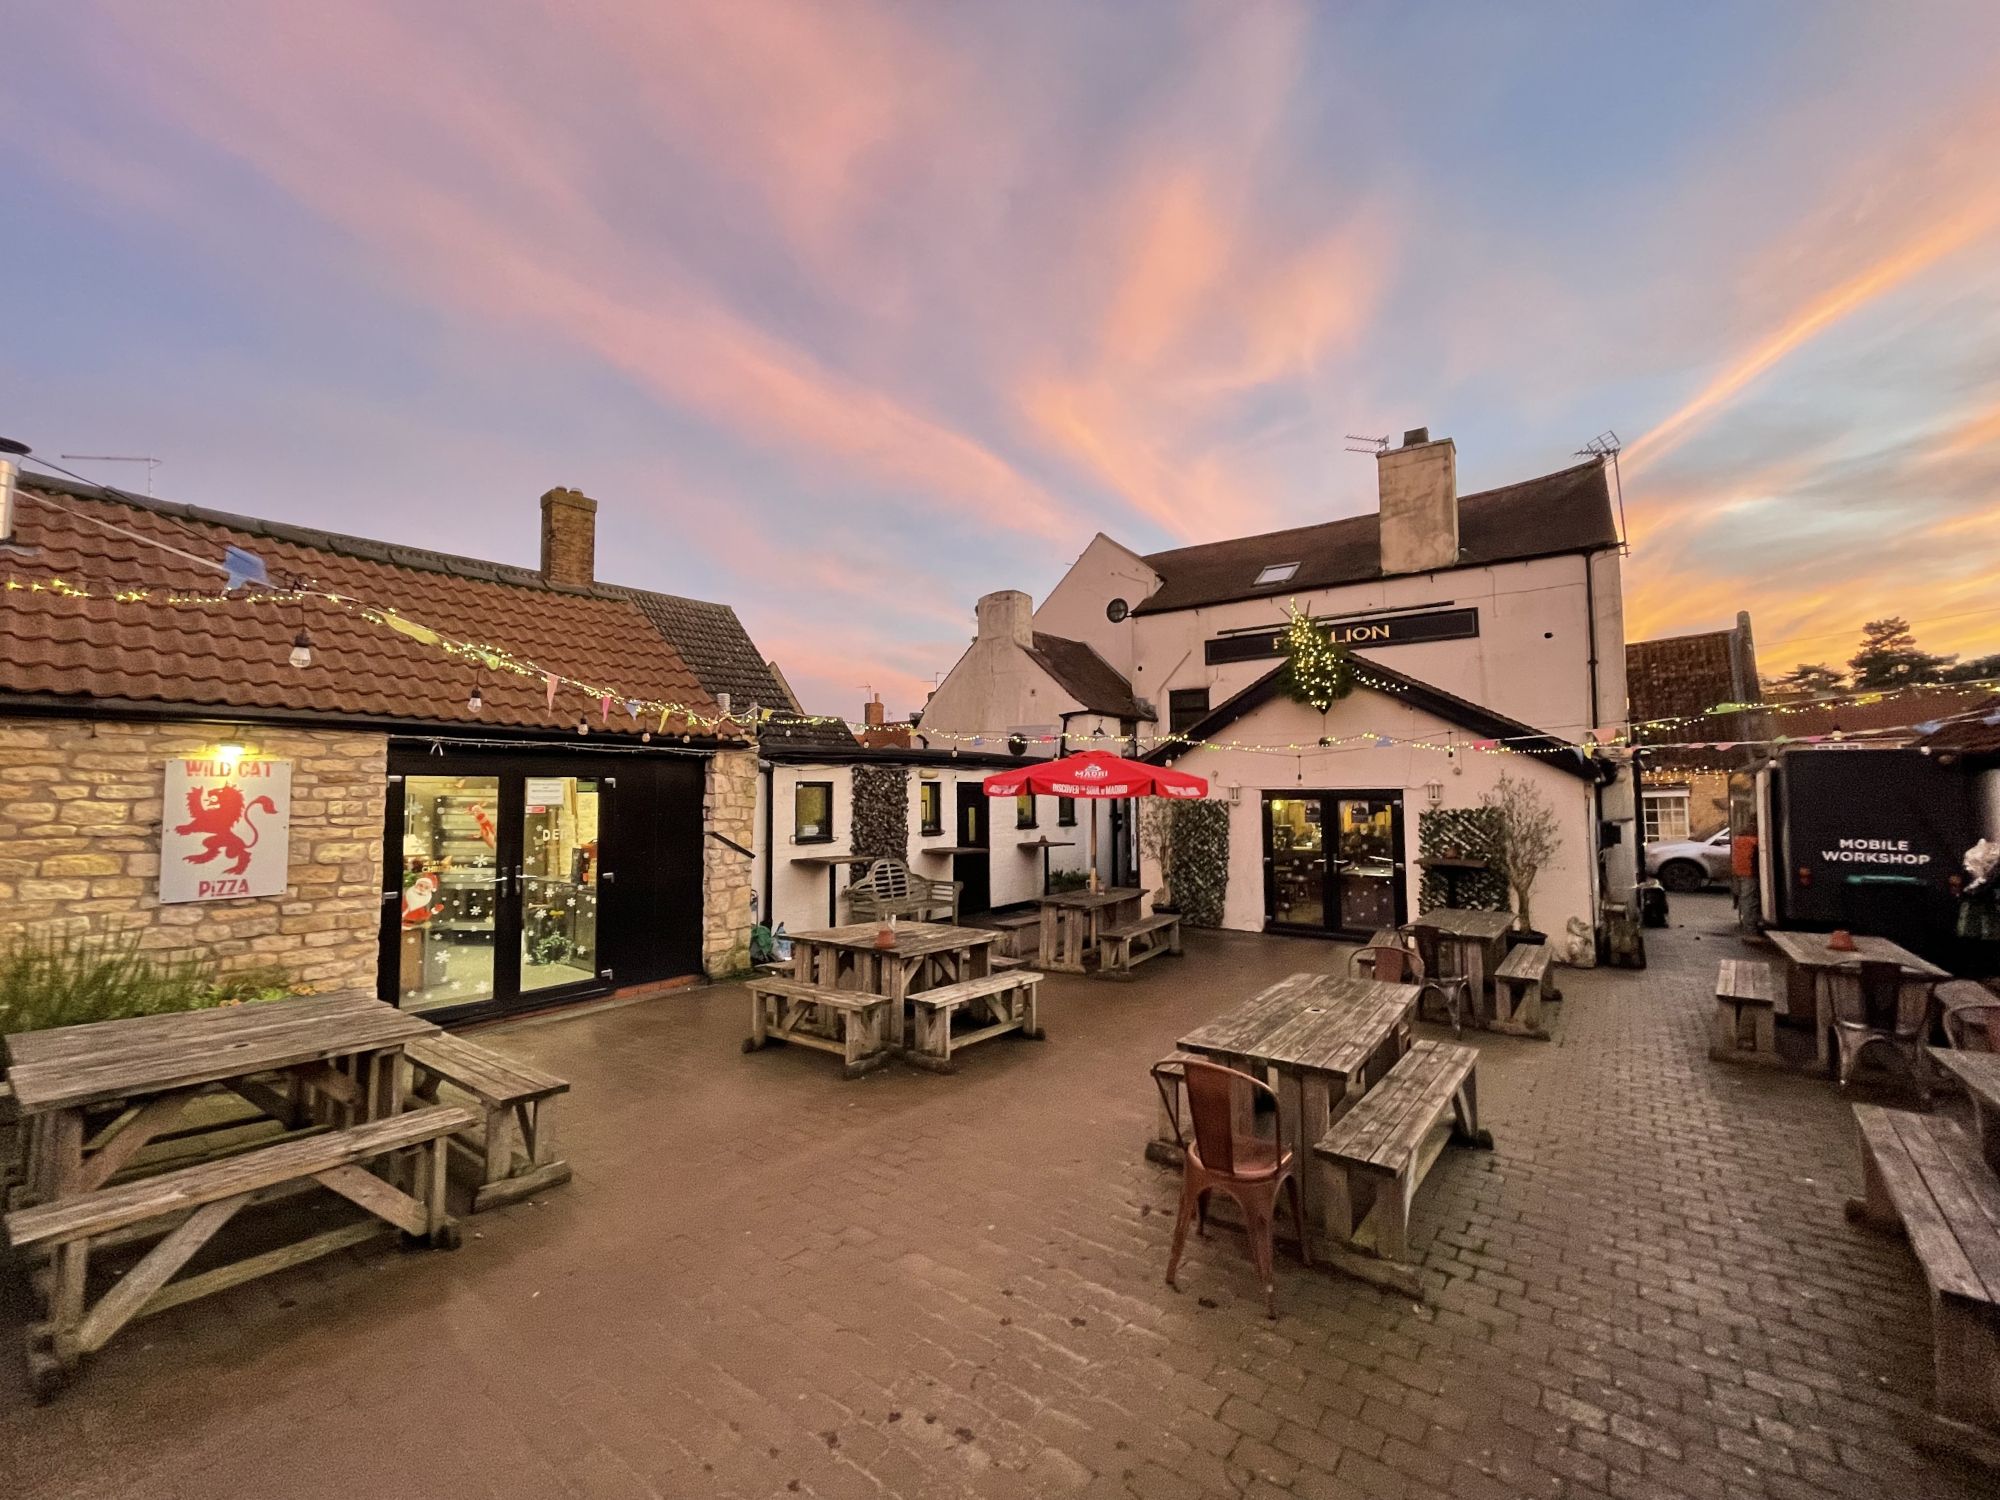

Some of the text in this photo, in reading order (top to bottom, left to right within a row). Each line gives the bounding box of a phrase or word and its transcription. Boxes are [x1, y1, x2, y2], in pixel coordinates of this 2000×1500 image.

[1329, 624, 1390, 644] LION
[184, 760, 272, 778] WILD CAT
[1052, 783, 1080, 795] DISCOVER
[1105, 784, 1128, 795] MADRID
[1839, 839, 1909, 851] MOBILE
[1822, 850, 1931, 865] WORKSHOP
[198, 879, 249, 897] PIZZA
